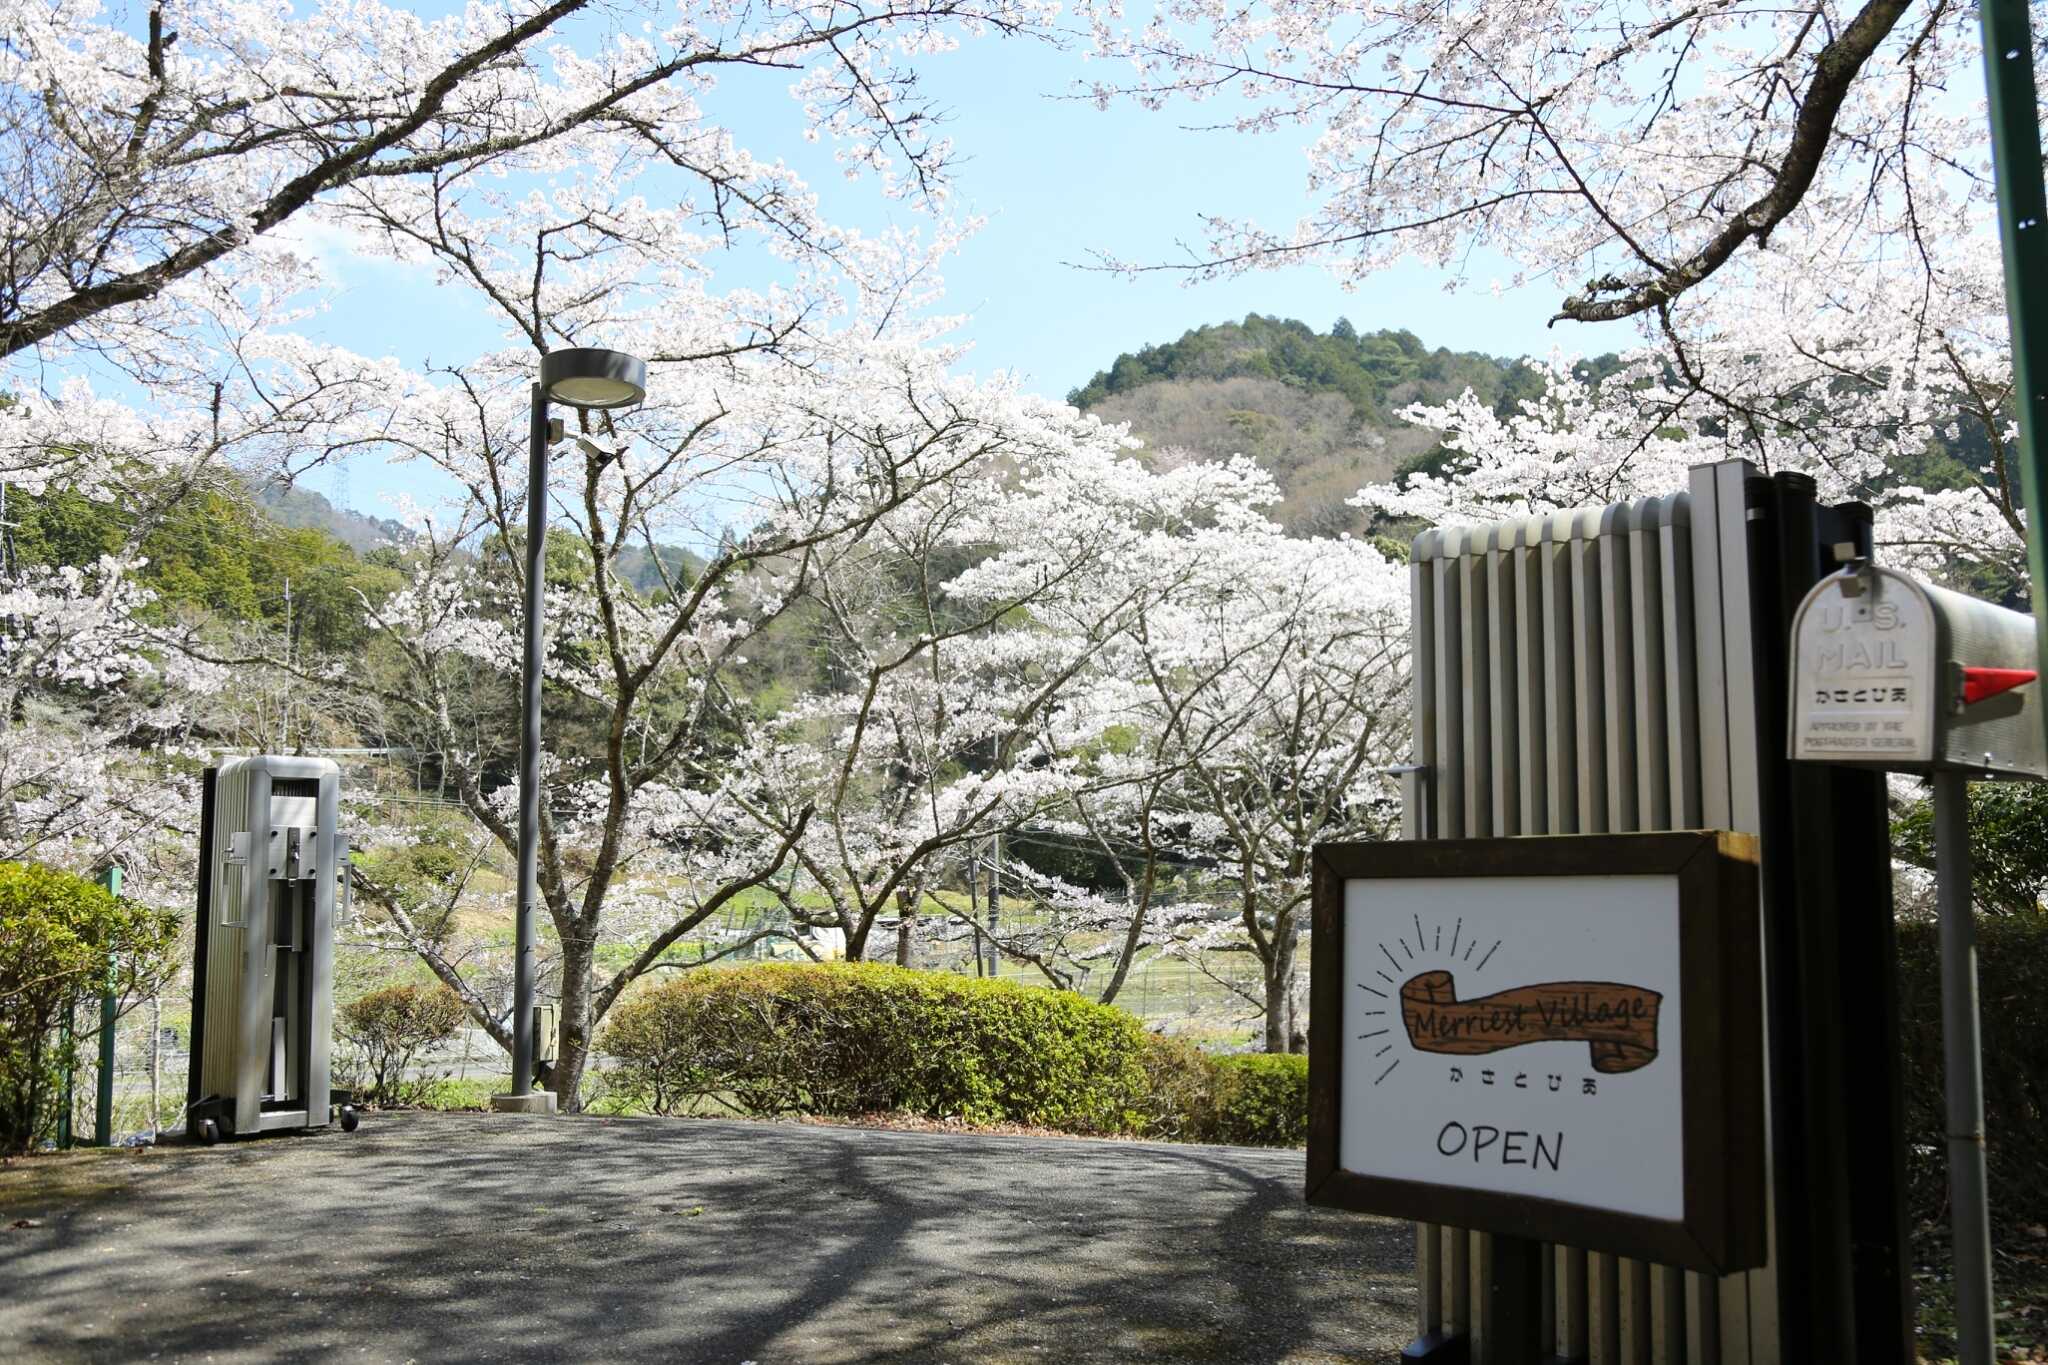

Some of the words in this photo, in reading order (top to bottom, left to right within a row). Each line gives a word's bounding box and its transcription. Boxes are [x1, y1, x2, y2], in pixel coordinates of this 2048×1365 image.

[1817, 641, 1909, 672] MAIL
[1413, 1000, 1525, 1040] Merriest
[1534, 992, 1648, 1030] Village
[1437, 1120, 1563, 1171] OPEN
